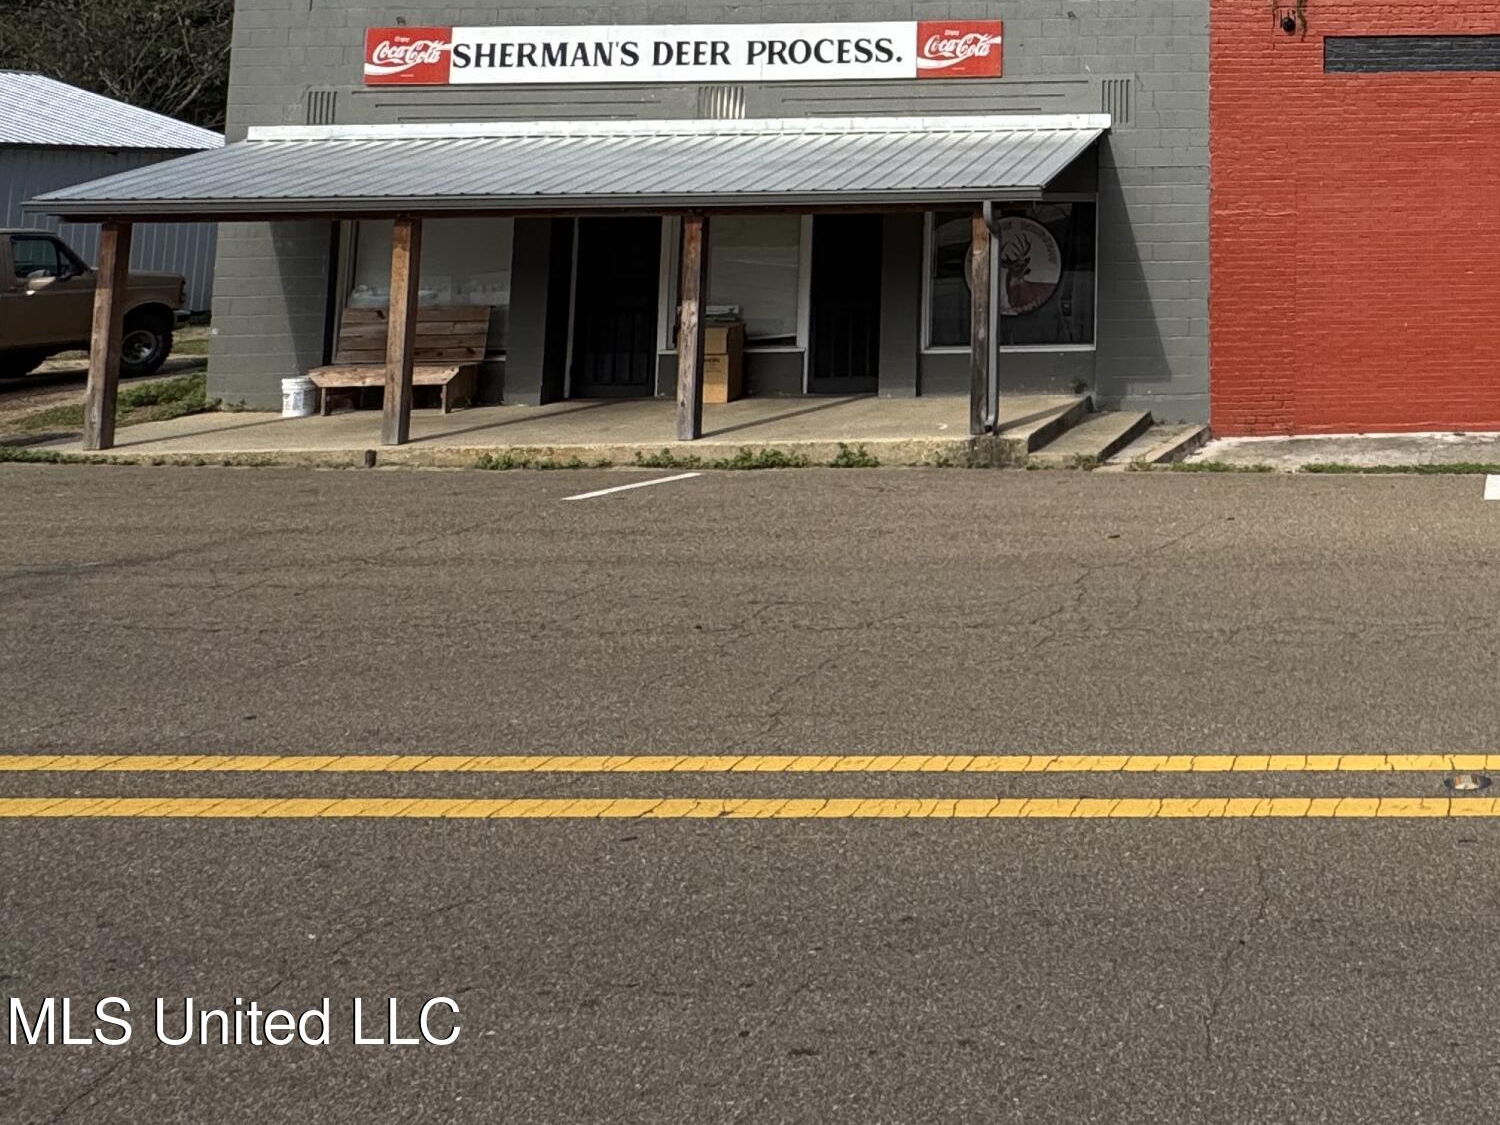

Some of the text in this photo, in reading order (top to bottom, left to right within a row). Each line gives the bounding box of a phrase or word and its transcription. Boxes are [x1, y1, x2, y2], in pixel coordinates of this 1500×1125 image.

[453, 38, 903, 68] SHERMAN'S DEER PROCESS.
